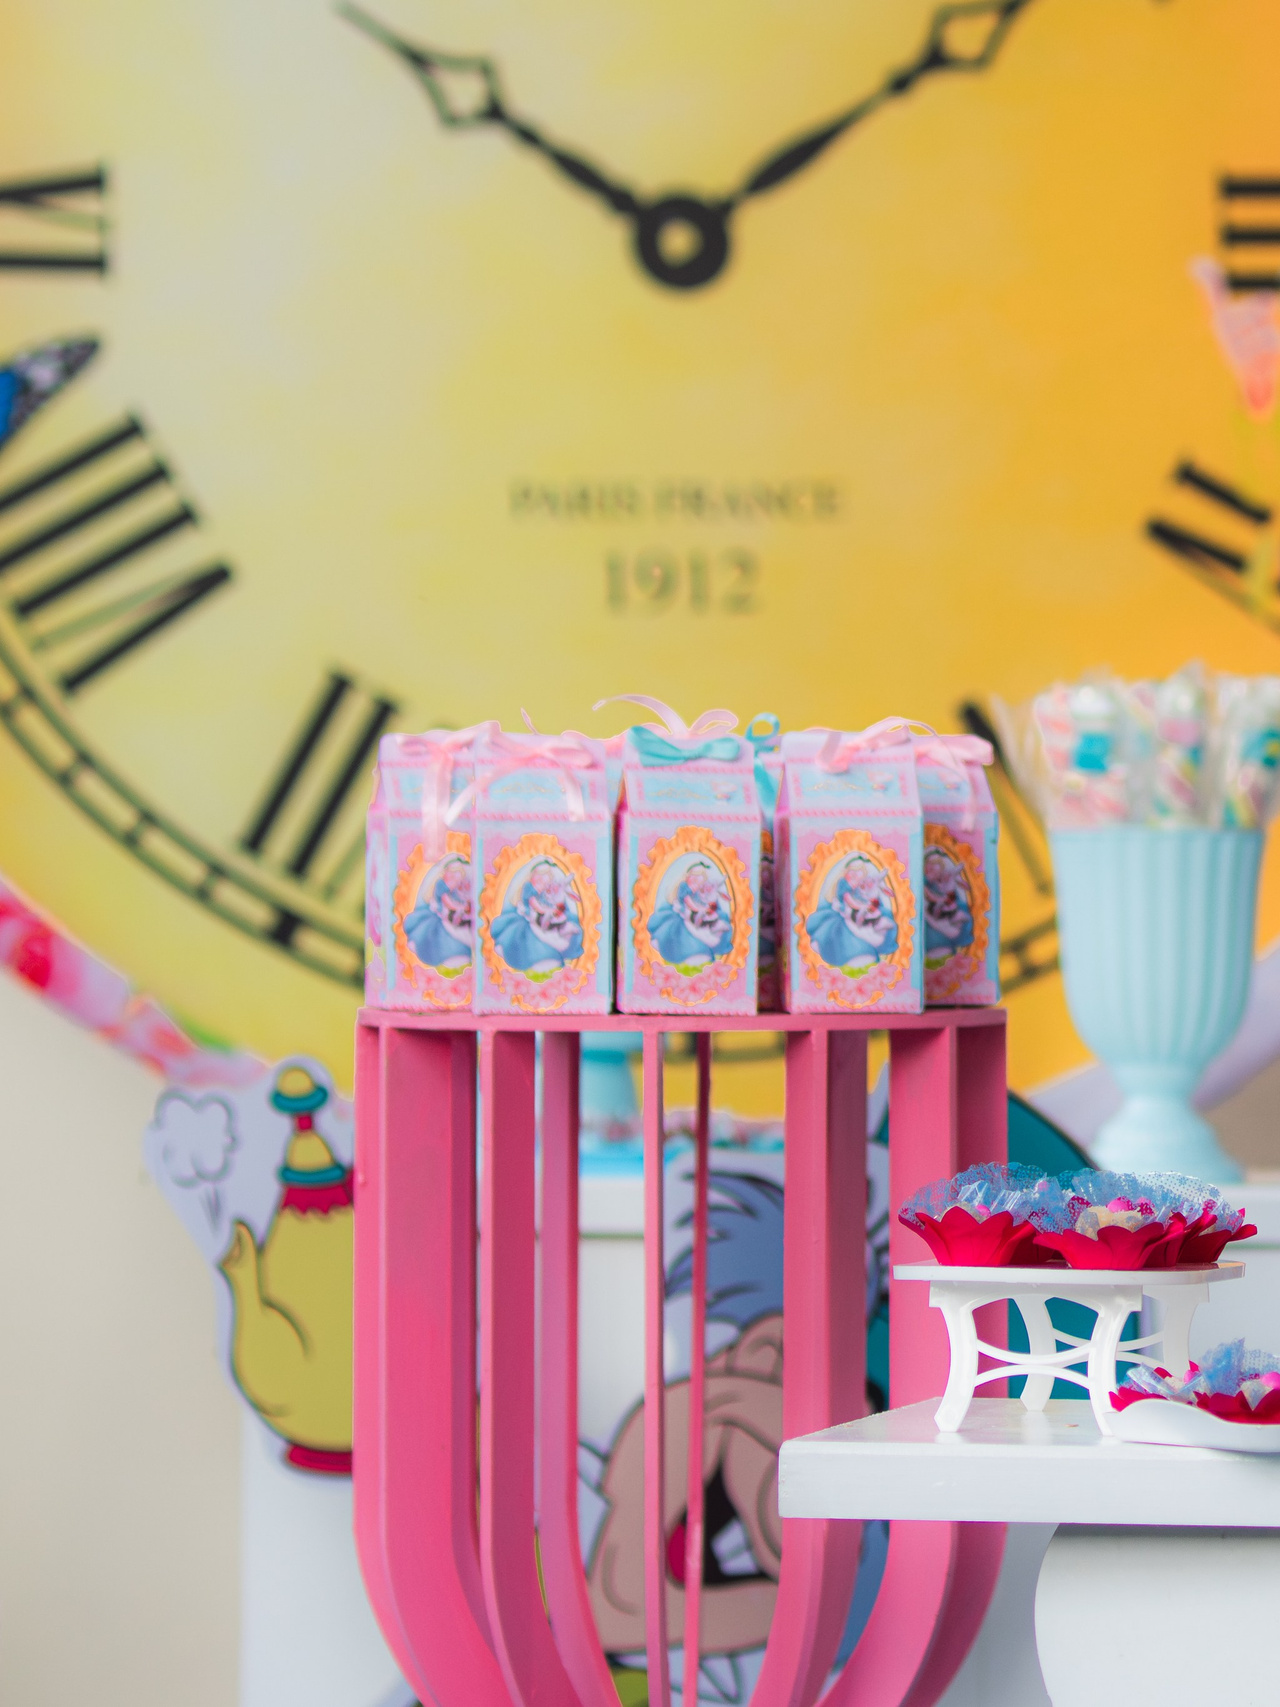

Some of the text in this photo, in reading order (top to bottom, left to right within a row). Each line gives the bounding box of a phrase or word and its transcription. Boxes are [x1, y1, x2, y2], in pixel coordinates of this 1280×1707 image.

[508, 479, 845, 523] PARIS FRANCE
[605, 549, 761, 616] 1912
